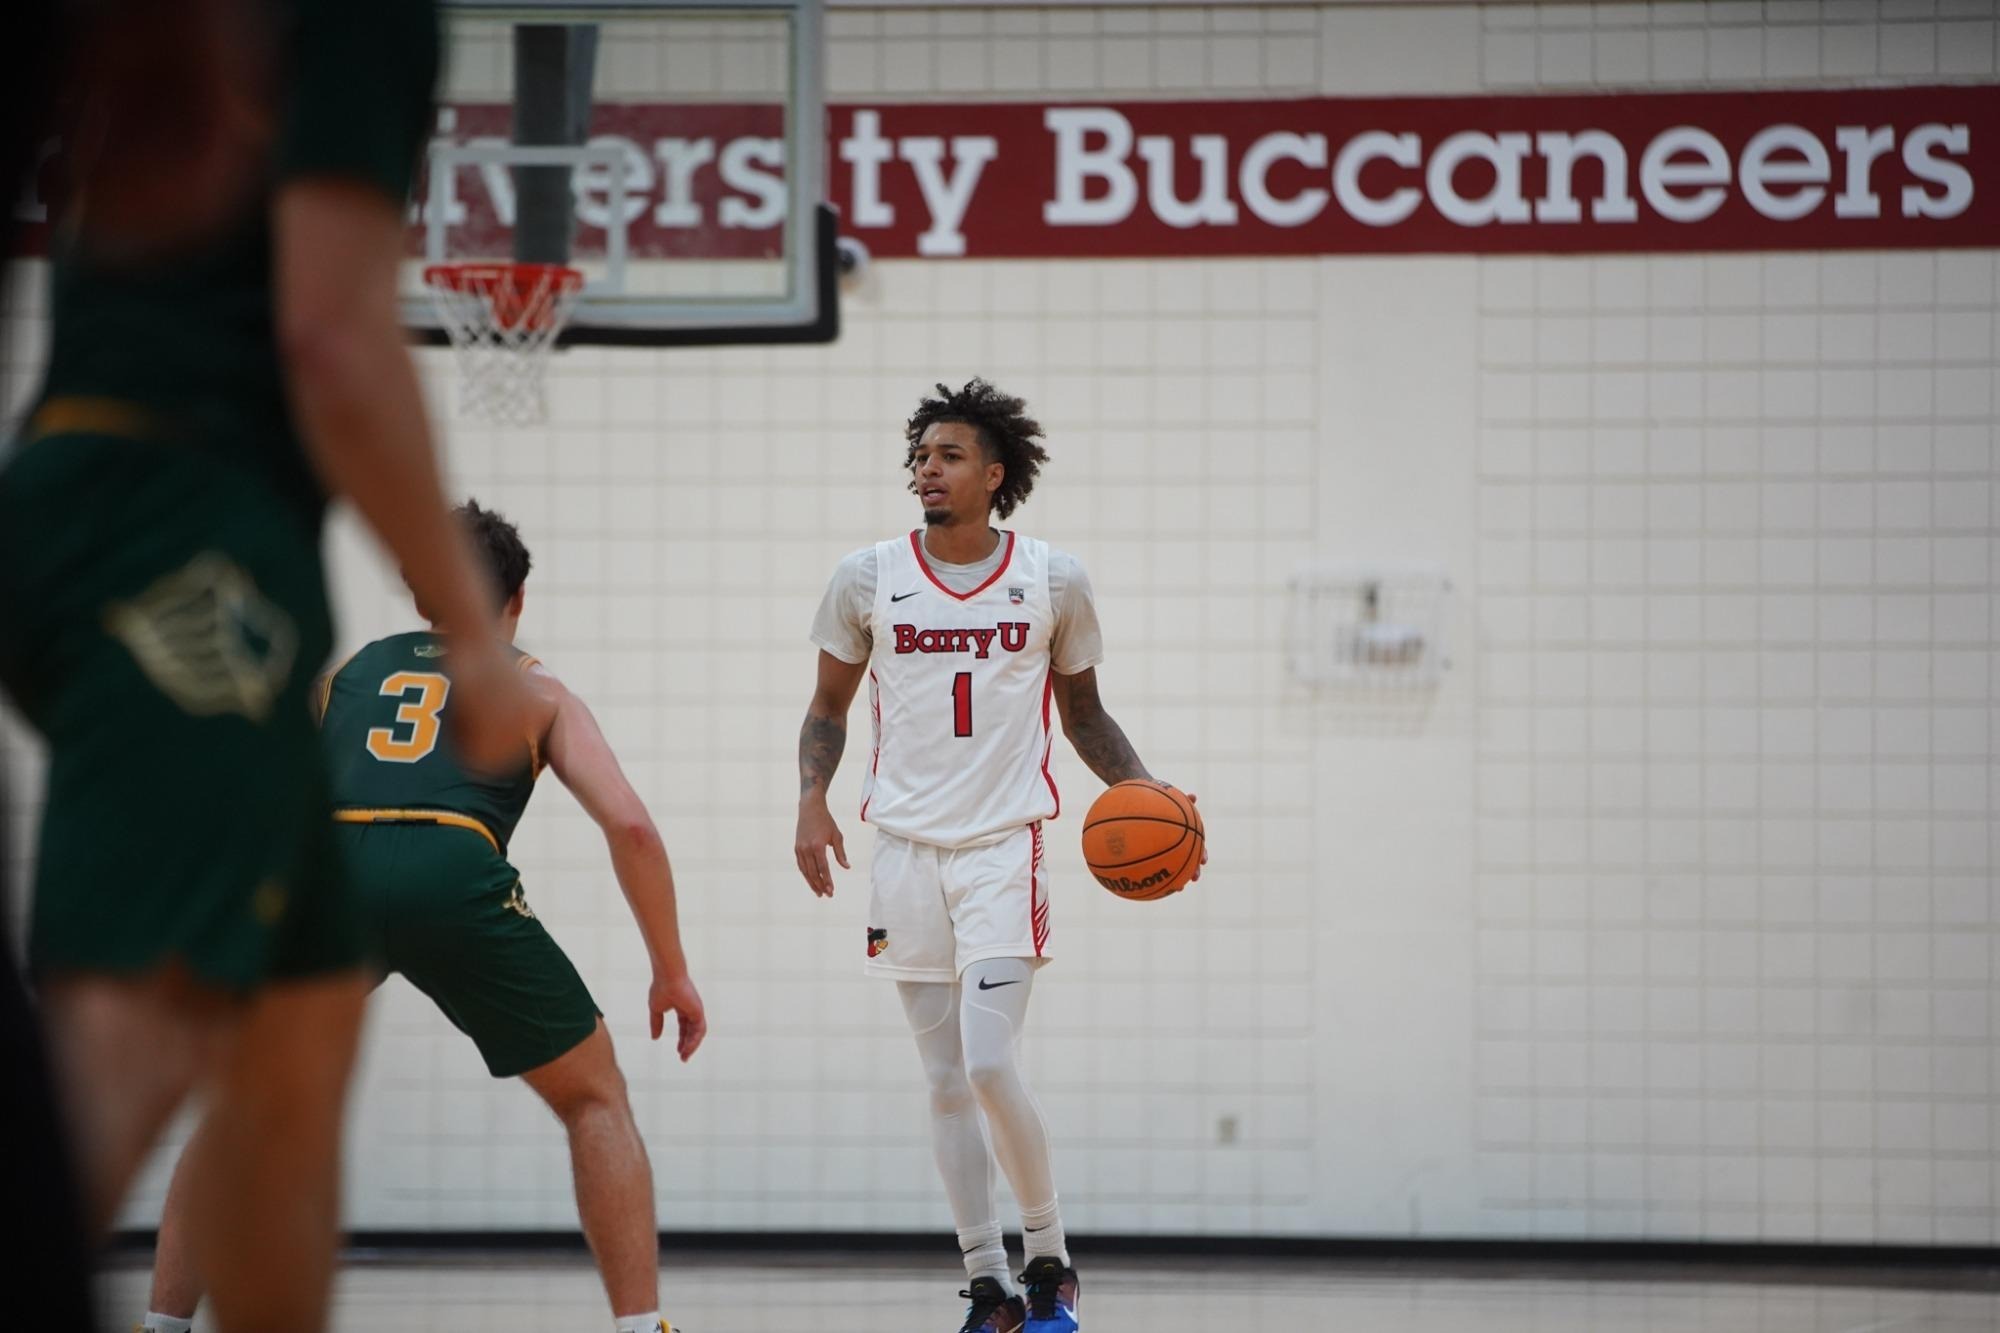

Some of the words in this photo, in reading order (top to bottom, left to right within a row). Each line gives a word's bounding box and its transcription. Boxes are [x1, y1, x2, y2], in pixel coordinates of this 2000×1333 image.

[1043, 106, 1974, 228] Buccaneers
[893, 624, 996, 659] Barry
[997, 622, 1030, 652] U
[366, 670, 451, 763] 3
[952, 672, 972, 737] 1
